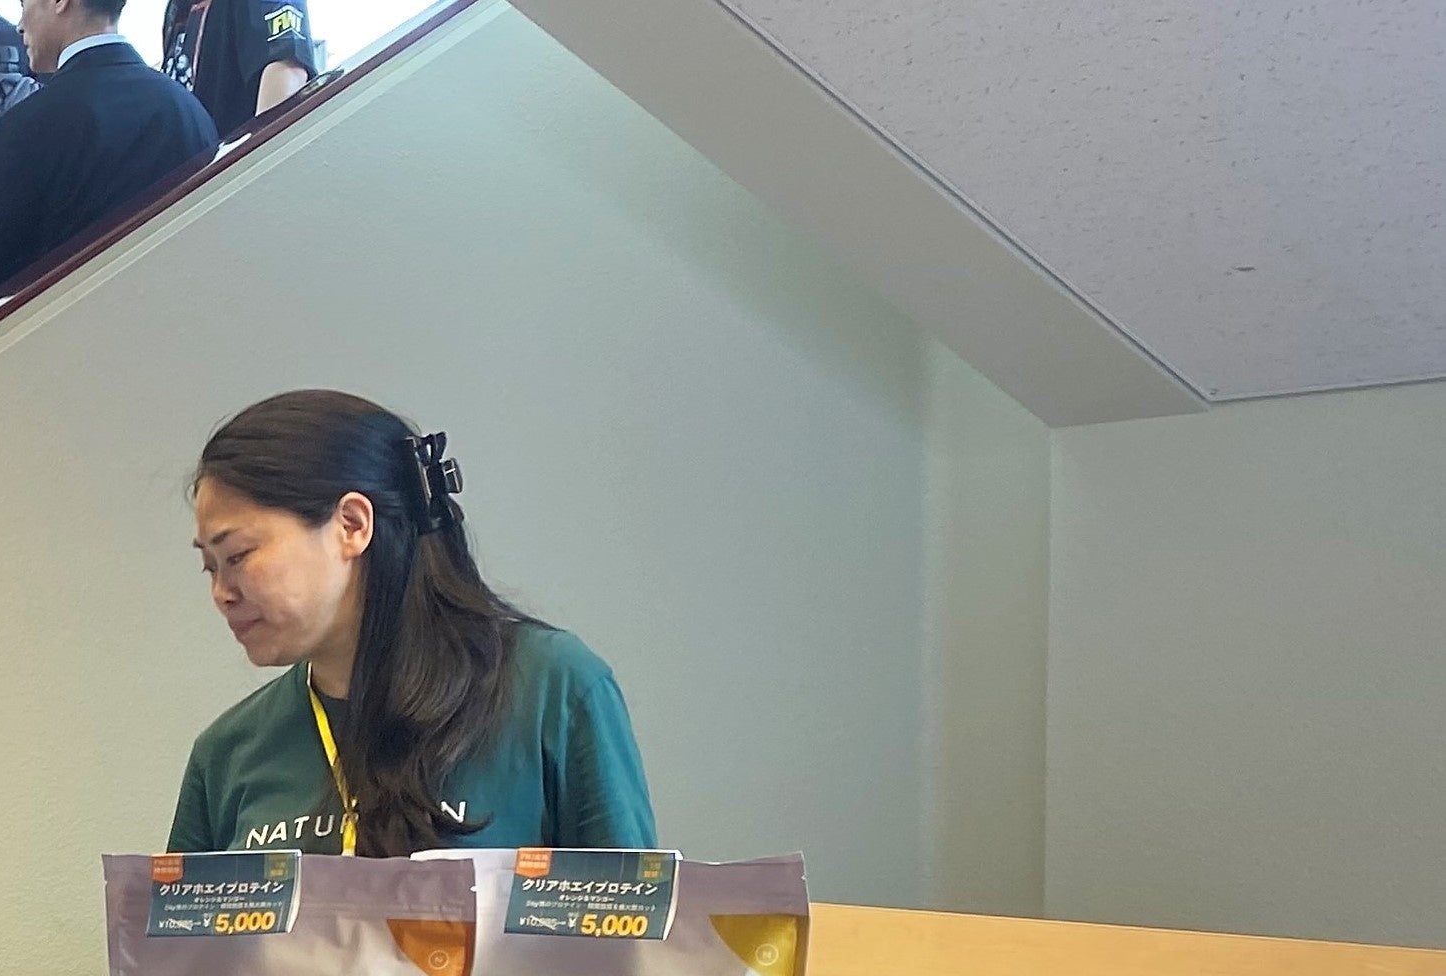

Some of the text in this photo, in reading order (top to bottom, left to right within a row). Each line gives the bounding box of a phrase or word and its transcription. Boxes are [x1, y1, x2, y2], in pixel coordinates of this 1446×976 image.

[159, 881, 284, 896] クリアホエイプロテイン
[522, 879, 658, 895] クリアホエイプロテイン
[214, 911, 276, 934] 5,000
[580, 913, 648, 938] 5,000
